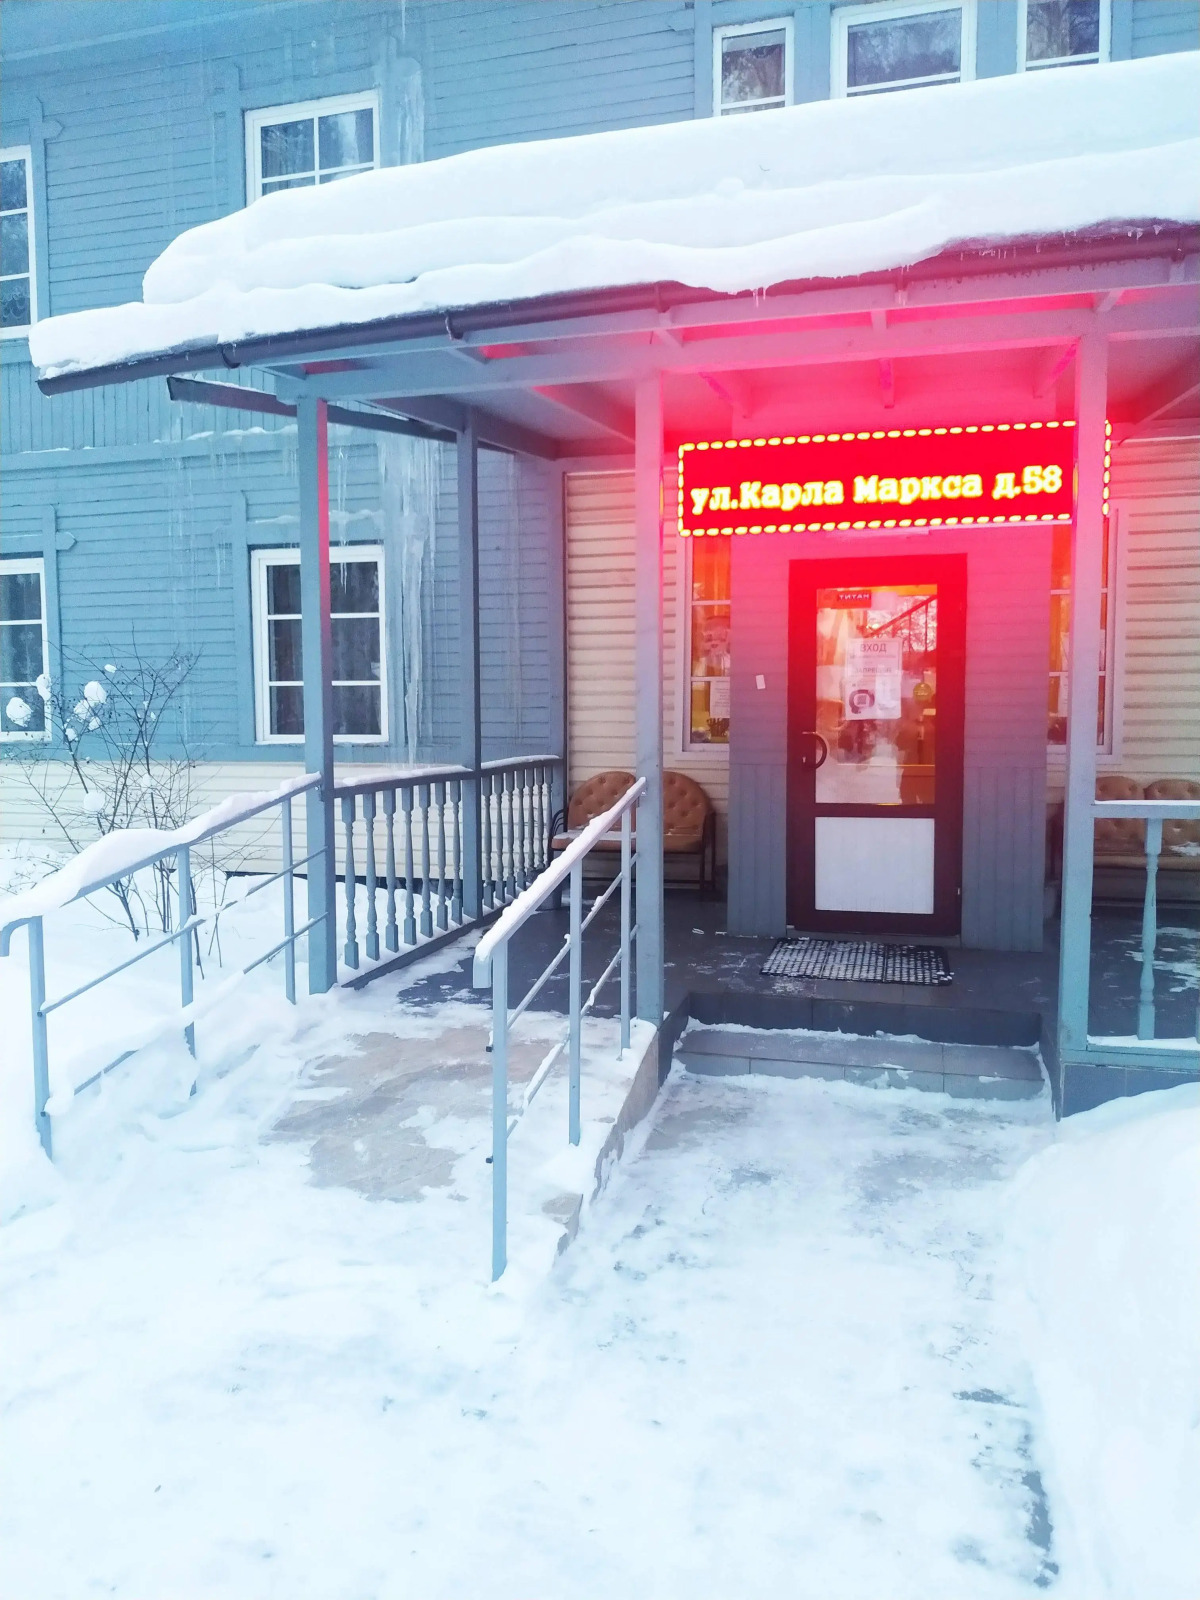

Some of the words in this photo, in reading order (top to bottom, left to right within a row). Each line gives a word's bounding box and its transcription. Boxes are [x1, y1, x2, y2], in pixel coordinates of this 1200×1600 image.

[690, 480, 845, 515] ул.Карла
[853, 474, 983, 505] Маркса
[992, 465, 1063, 500] д.58
[839, 593, 870, 601] ТИТАН
[860, 642, 887, 653] ВХОД
